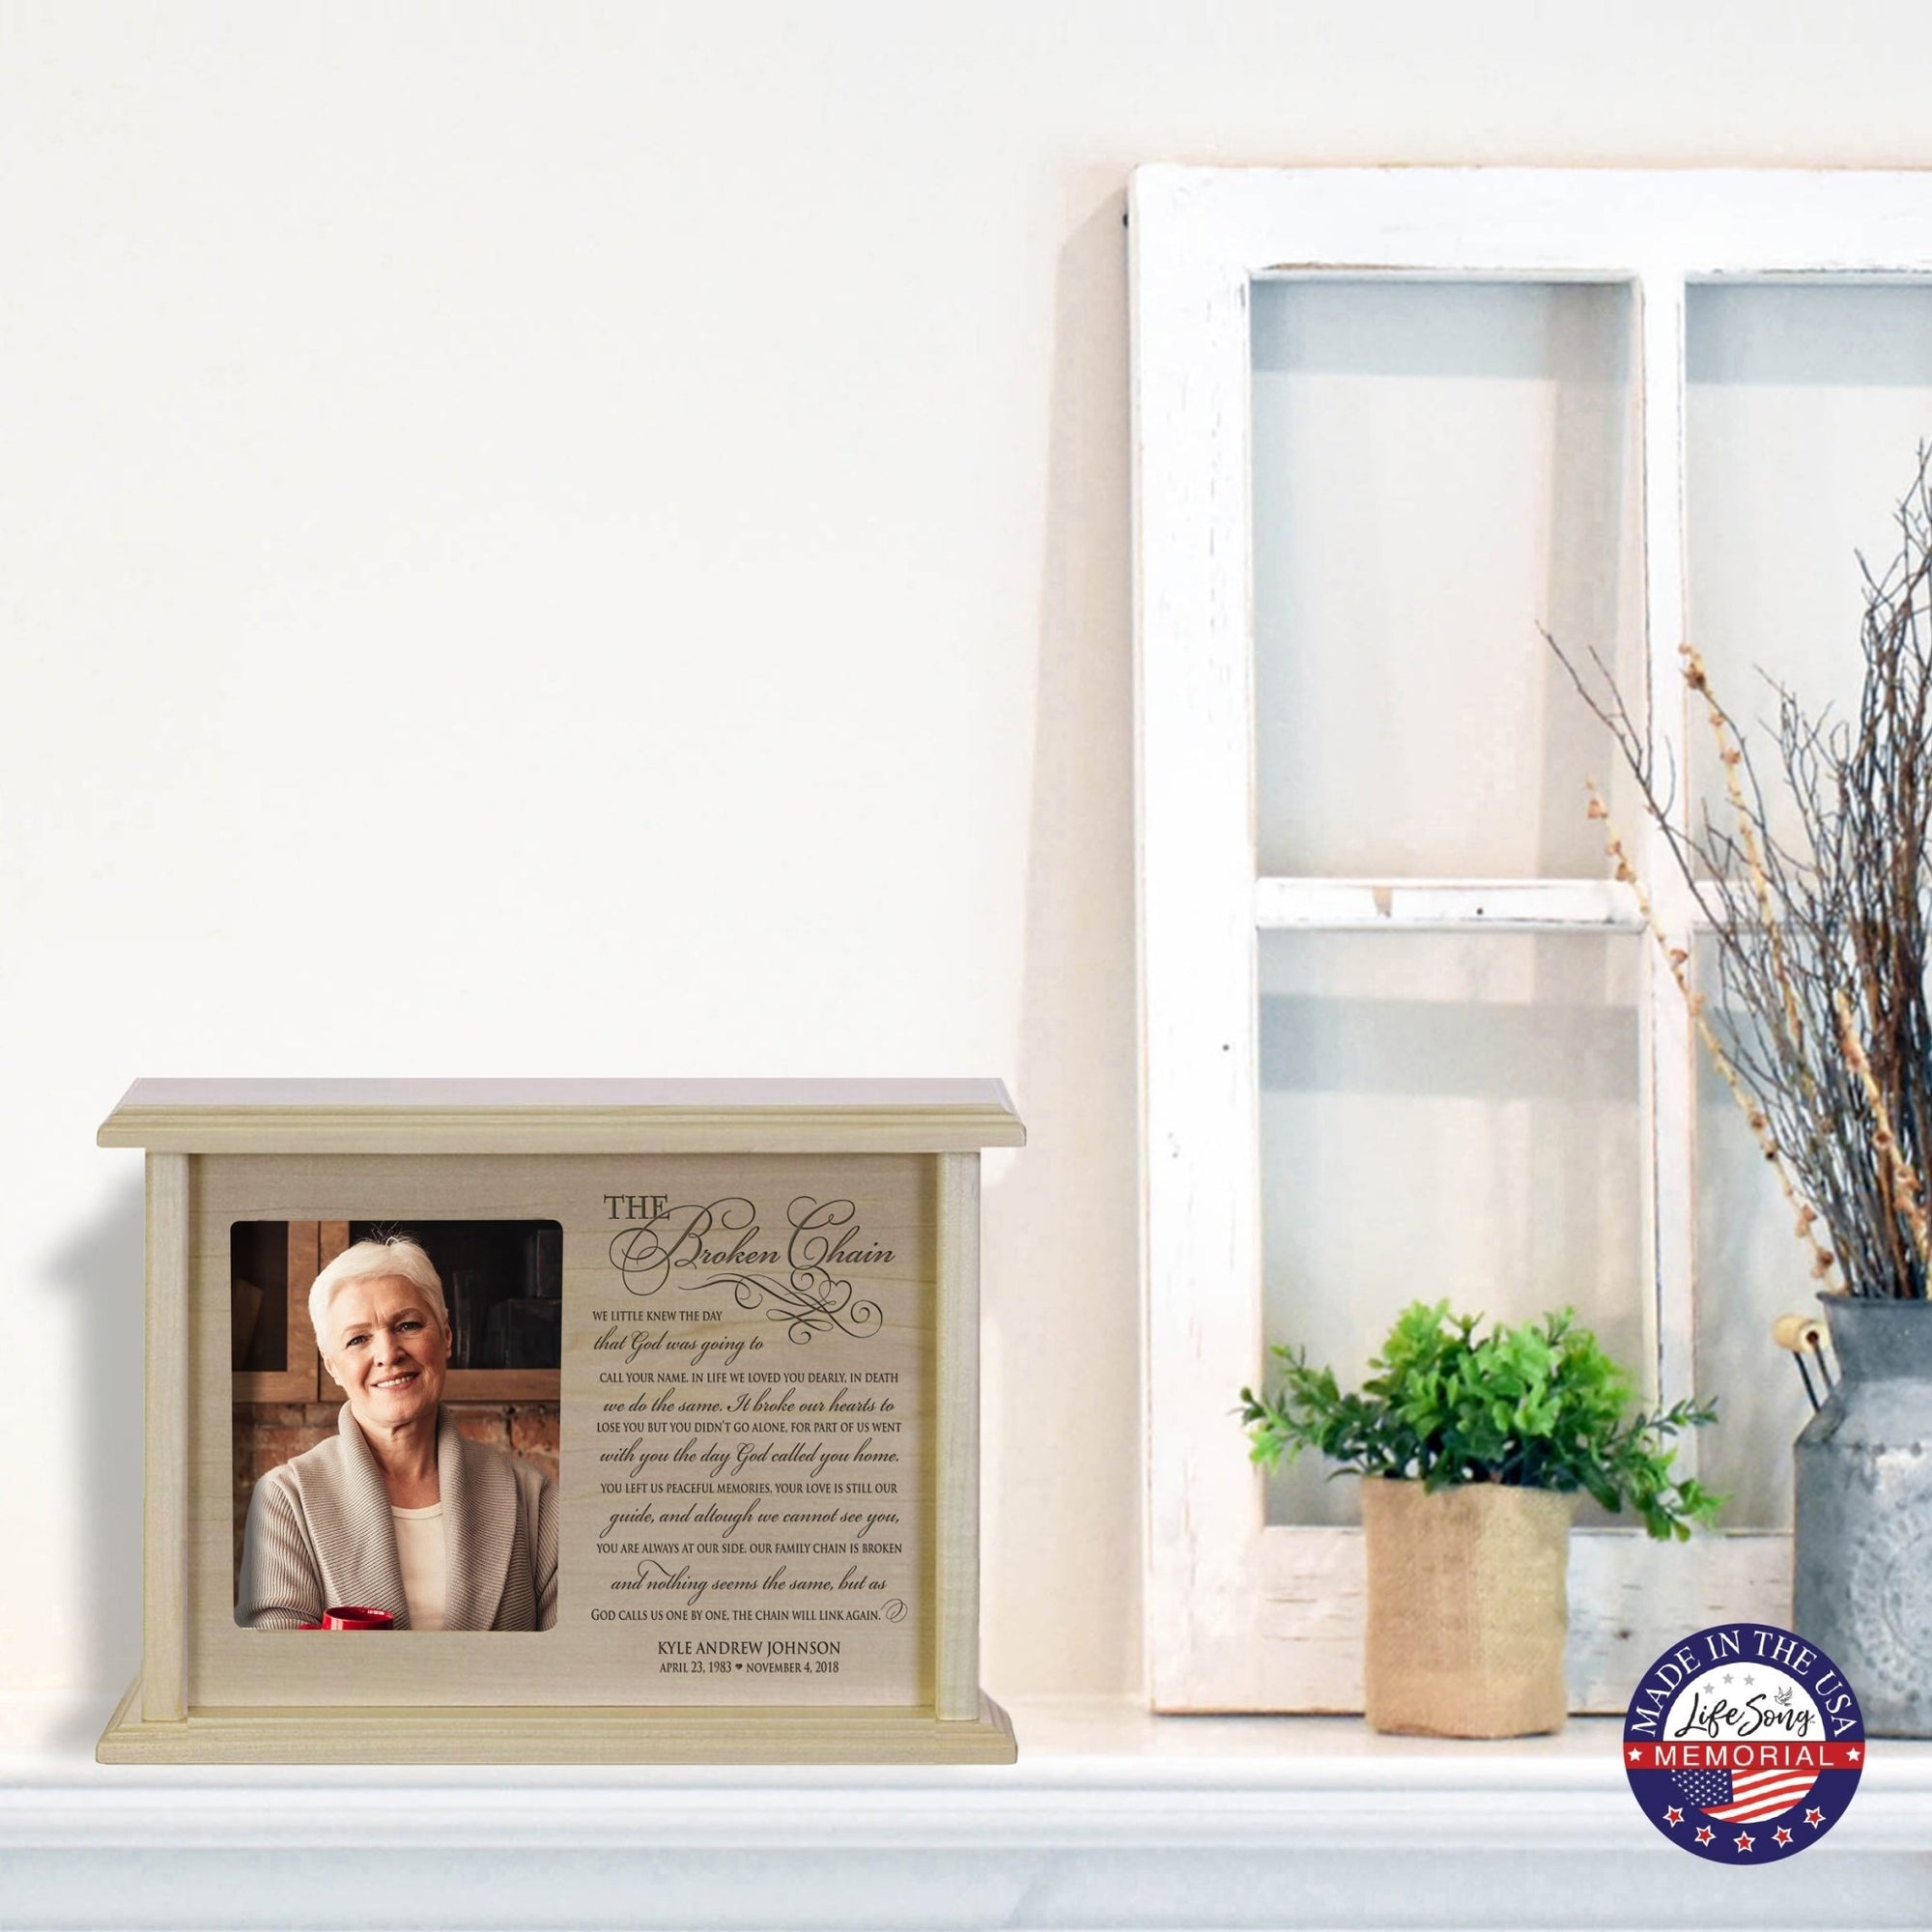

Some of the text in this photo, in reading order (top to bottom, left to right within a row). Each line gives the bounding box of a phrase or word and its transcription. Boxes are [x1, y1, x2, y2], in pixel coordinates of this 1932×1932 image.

[604, 1194, 669, 1220] THE
[609, 1196, 895, 1295] Broken Chain
[592, 1311, 723, 1321] WE LITTLE KNEW THE DAY
[593, 1325, 764, 1366] that God was going to
[600, 1373, 624, 1383] CALL
[626, 1373, 656, 1383] YOUR
[692, 1373, 704, 1383] IN
[706, 1373, 727, 1383] LIFE
[729, 1373, 746, 1383] WE
[748, 1373, 781, 1383] LOVED
[783, 1373, 805, 1383] YOU
[808, 1373, 846, 1384] DEARLY,
[849, 1373, 862, 1383] IN
[865, 1373, 898, 1383] DEATH
[604, 1387, 895, 1412] we do the same. It broke our hearts to
[596, 1420, 901, 1434] LOSE YOU BUT YOU DIDN'T GO ALONE, FOR PART OF US WENT
[600, 1437, 899, 1478] with you the day God called you home.
[601, 1484, 897, 1494] YOU LEFT US PEACEFUL MEMORIES, YOUR LOVE IS STILL OUR
[600, 1498, 900, 1539] guide, and altough we cannot see you,
[596, 1544, 619, 1553] YOU
[621, 1544, 639, 1553] ARE
[642, 1544, 679, 1553] ALWAYS
[682, 1544, 695, 1553] AT
[697, 1544, 720, 1553] OUR
[750, 1544, 773, 1553] OUR
[775, 1544, 810, 1553] FAMILY
[812, 1544, 846, 1553] CHAIN
[850, 1544, 860, 1553] IS
[862, 1544, 902, 1553] BROKEN
[645, 1565, 709, 1606] nothing
[711, 1580, 757, 1590] seems
[762, 1565, 786, 1590] the
[789, 1580, 834, 1592] same,
[838, 1565, 867, 1590] but
[868, 1580, 887, 1590] as
[618, 1610, 648, 1621] CALLS
[651, 1610, 664, 1621] US
[666, 1610, 689, 1621] ONE
[691, 1610, 703, 1621] BY
[732, 1610, 753, 1621] THE
[755, 1610, 789, 1621] CHAIN
[792, 1610, 817, 1621] WILL
[819, 1610, 844, 1621] LINK
[845, 1610, 881, 1621] AGAIN.
[658, 1641, 840, 1658] KYLE ANDREW JOHNSON
[660, 1662, 838, 1674] APRIL 23, 1983 NOVEMBER 4, 2018
